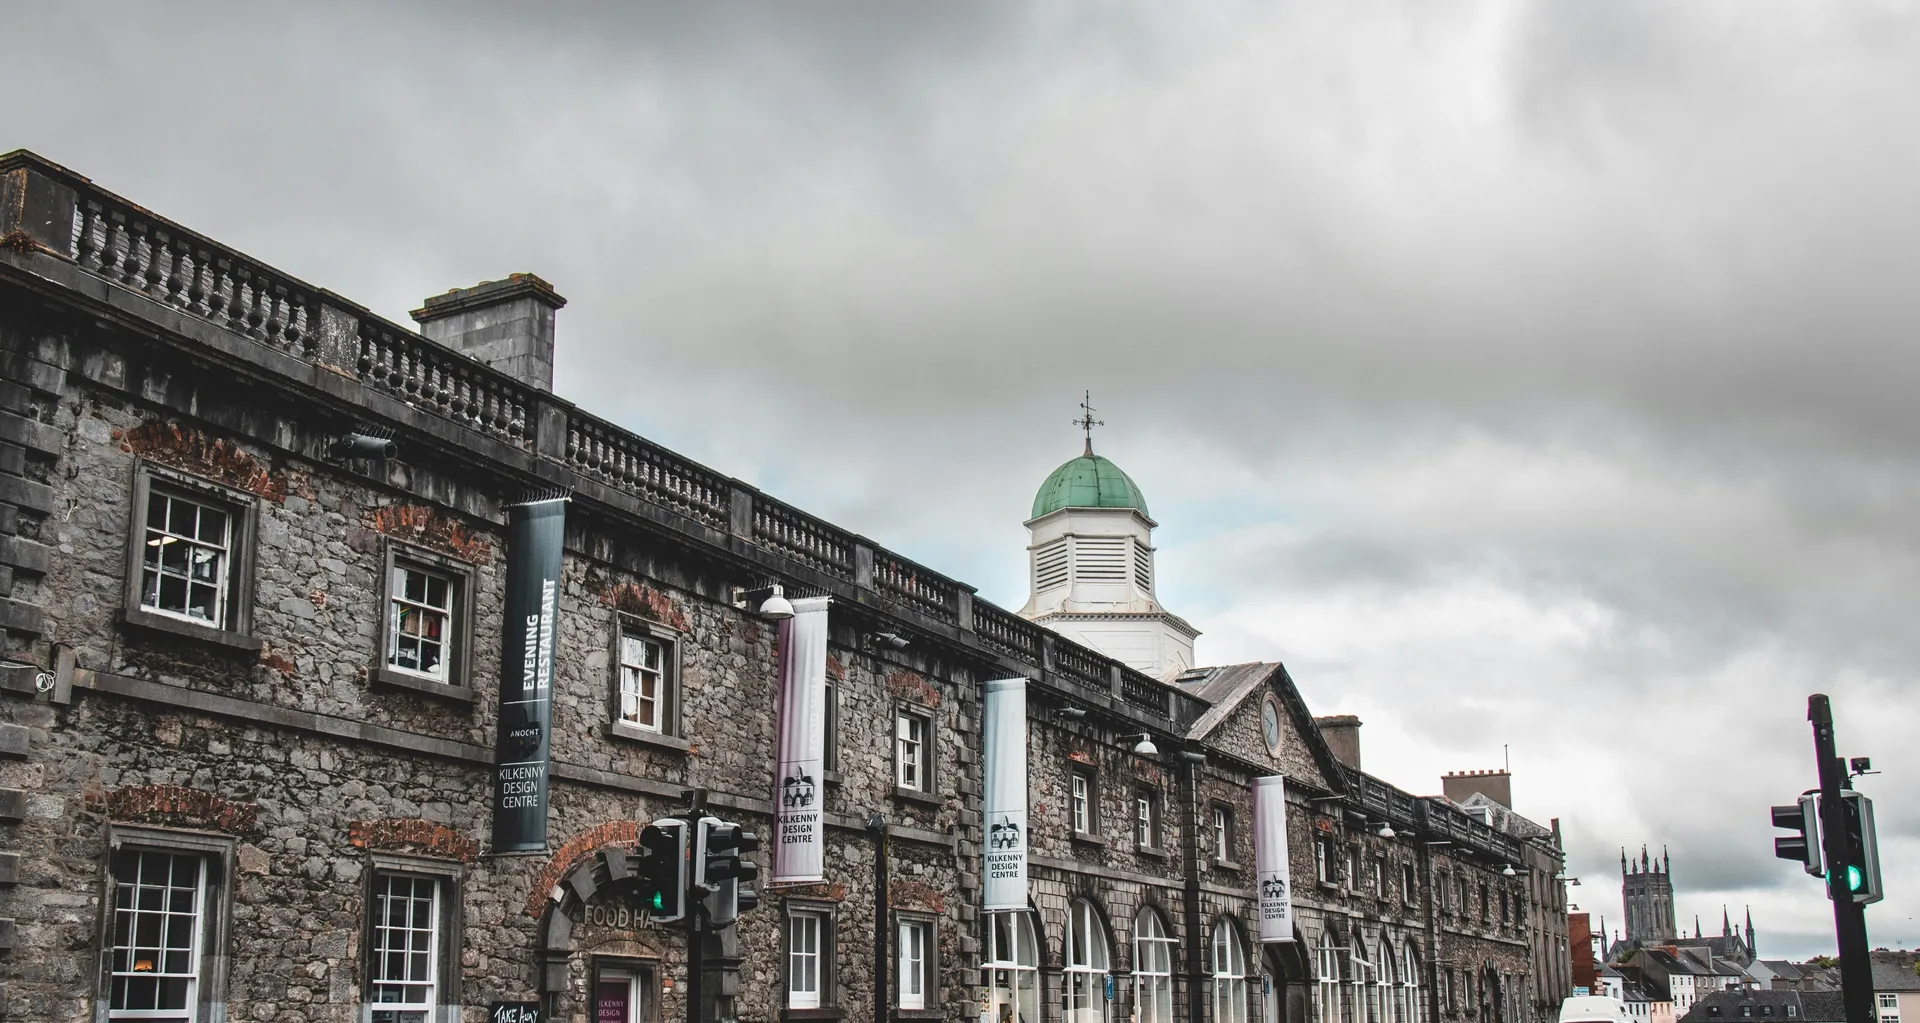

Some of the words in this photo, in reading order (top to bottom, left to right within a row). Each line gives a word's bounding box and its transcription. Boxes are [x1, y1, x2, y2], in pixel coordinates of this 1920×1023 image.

[537, 579, 555, 689] RESTAURANT
[523, 614, 539, 690] EVENING
[510, 728, 540, 738] ANOCHT
[500, 766, 545, 780] KILKENNY
[503, 781, 538, 794] DESIGN
[503, 795, 538, 809] CENTRE
[777, 814, 818, 823] KILKENNY
[782, 824, 812, 834] DESIGN
[782, 835, 813, 844] CENTRE
[987, 854, 1023, 862] KILKENNY
[991, 871, 1018, 879] CENTRE
[584, 904, 629, 928] FOOD
[598, 999, 625, 1008] ILKENNY
[494, 1005, 517, 1023] TAKE
[598, 1009, 621, 1017] DESIGN
